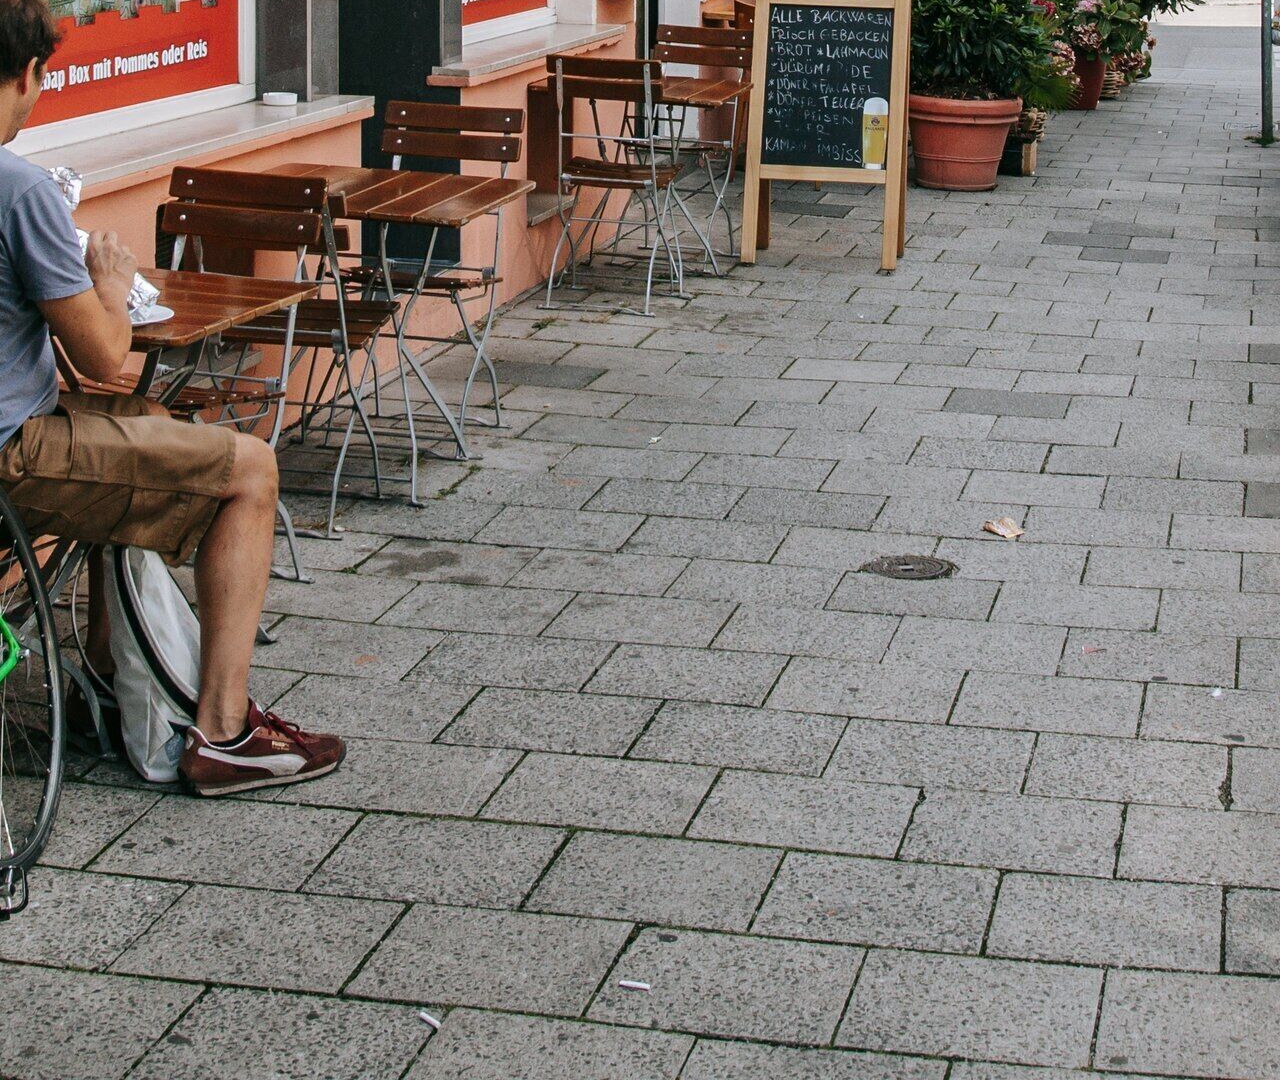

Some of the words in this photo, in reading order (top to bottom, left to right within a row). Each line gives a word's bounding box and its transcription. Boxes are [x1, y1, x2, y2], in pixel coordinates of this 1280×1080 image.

[771, 6, 802, 24] ALLE
[69, 64, 90, 86] Box
[93, 58, 112, 81] mit
[114, 51, 159, 77] Pommes
[162, 44, 185, 66] oder
[187, 38, 208, 61] Reis
